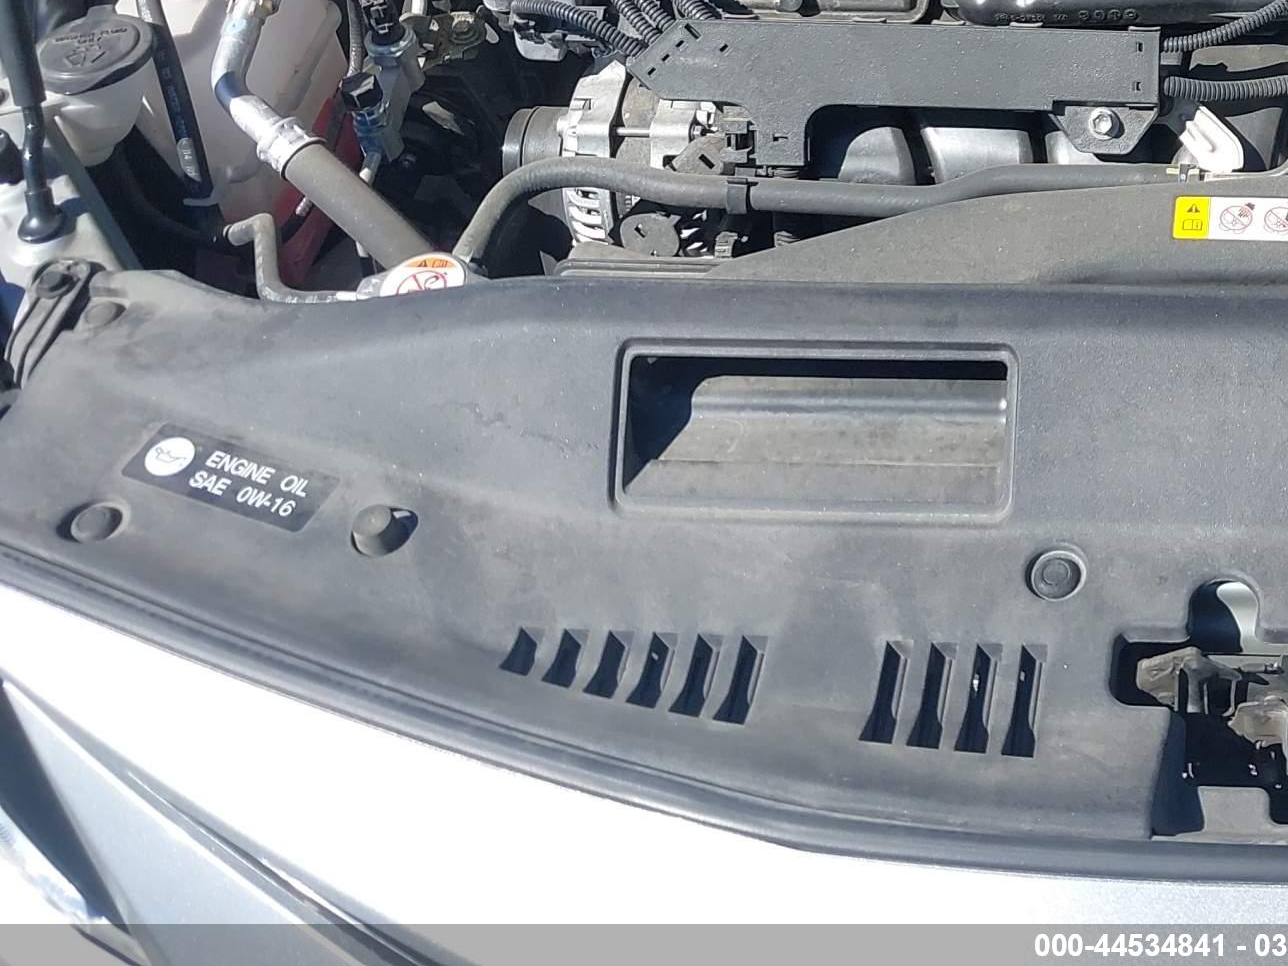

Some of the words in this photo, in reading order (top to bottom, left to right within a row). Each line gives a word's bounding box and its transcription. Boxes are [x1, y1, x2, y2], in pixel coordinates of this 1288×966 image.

[189, 471, 232, 496] SAE
[236, 486, 296, 517] 0W-16
[205, 450, 276, 485] ENGINE
[280, 475, 309, 497] OIL
